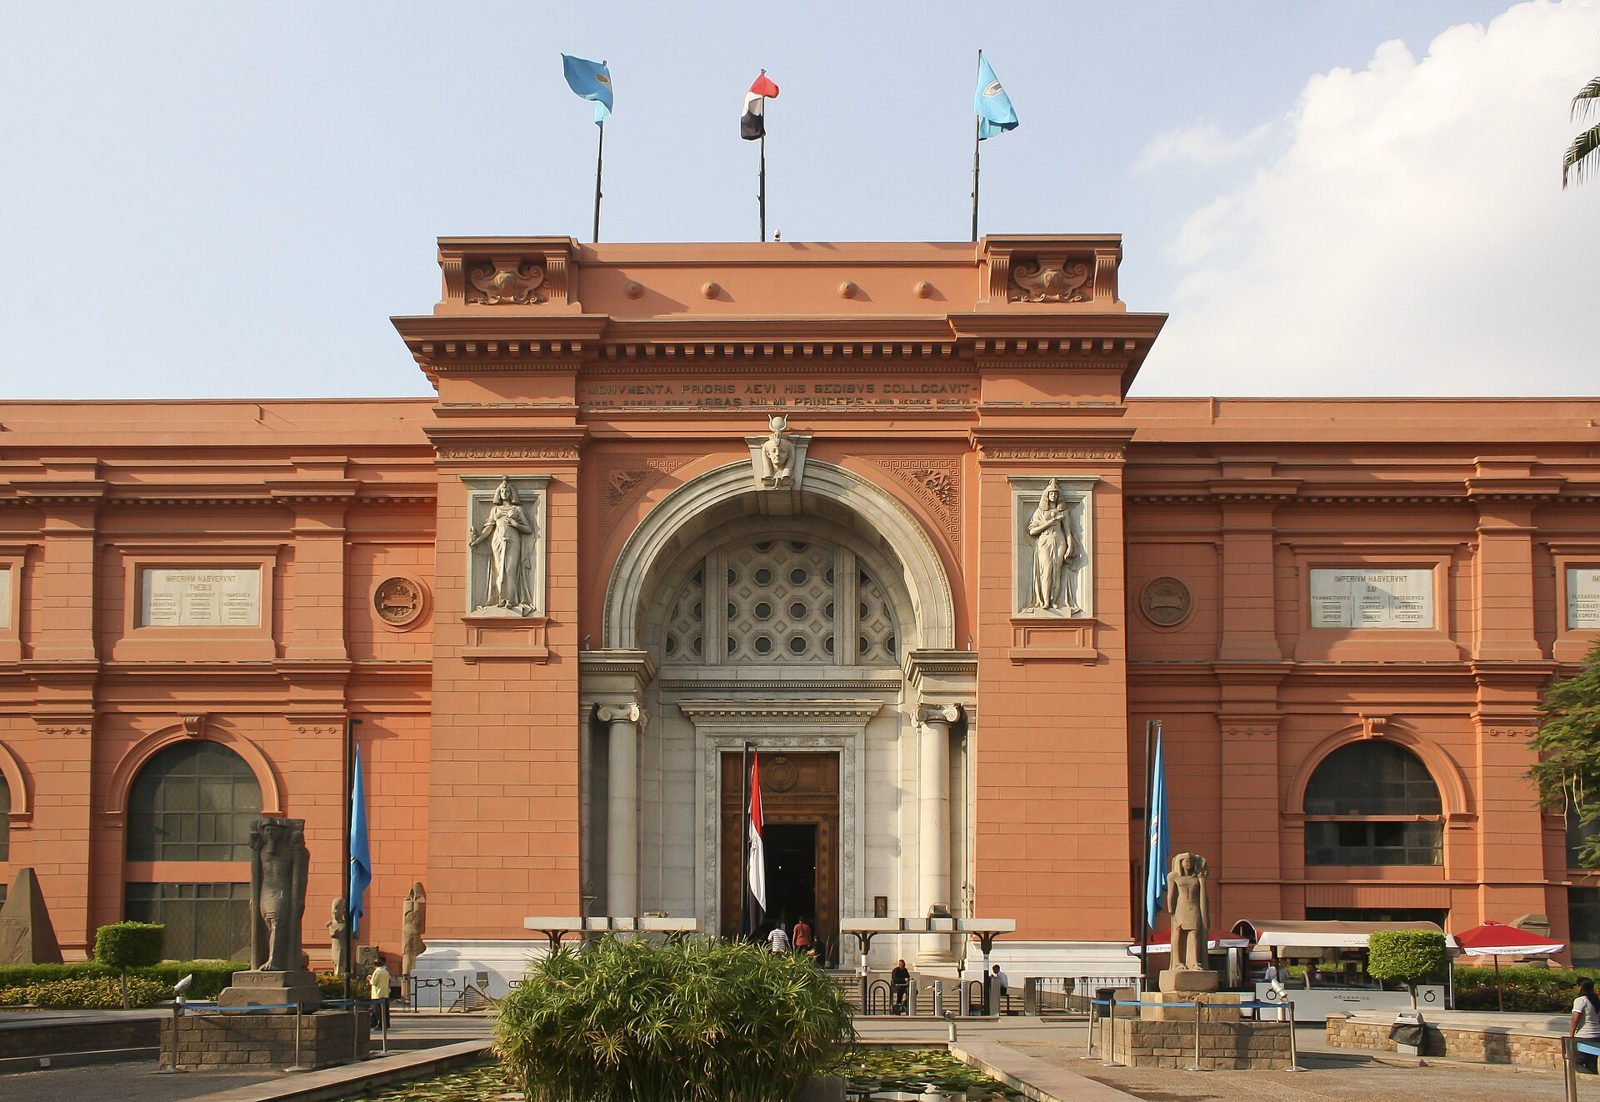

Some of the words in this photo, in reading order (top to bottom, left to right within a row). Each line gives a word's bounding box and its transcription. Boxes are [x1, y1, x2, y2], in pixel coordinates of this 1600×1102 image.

[586, 384, 673, 395] MONVMENTA
[681, 384, 736, 394] PRIORIS
[745, 384, 776, 394] AEVI
[784, 384, 805, 394] HIS
[814, 384, 874, 394] SEDIBVS
[883, 384, 970, 394] COLLOCAVIT
[166, 575, 195, 583] IMPERIVM
[198, 575, 236, 583] HABVERVNT
[1335, 575, 1366, 583] IMPERIVM
[1368, 575, 1408, 583] HABVERVNT
